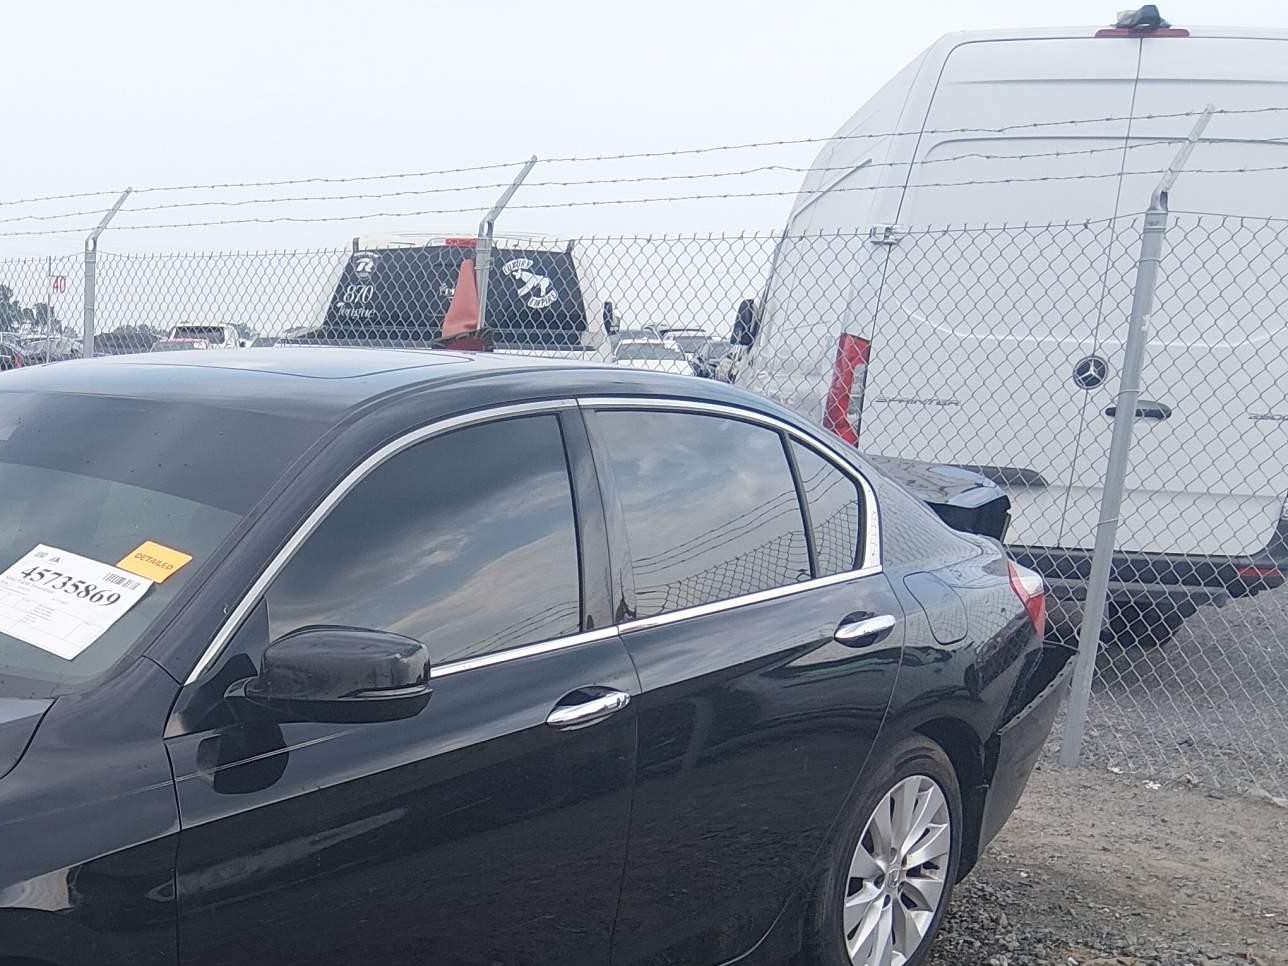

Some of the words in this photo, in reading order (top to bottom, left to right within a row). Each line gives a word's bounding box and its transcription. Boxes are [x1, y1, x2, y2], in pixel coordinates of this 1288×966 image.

[53, 275, 66, 293] 40
[343, 284, 374, 303] 870
[134, 552, 174, 570] DETAILED
[21, 566, 121, 607] 45735869
